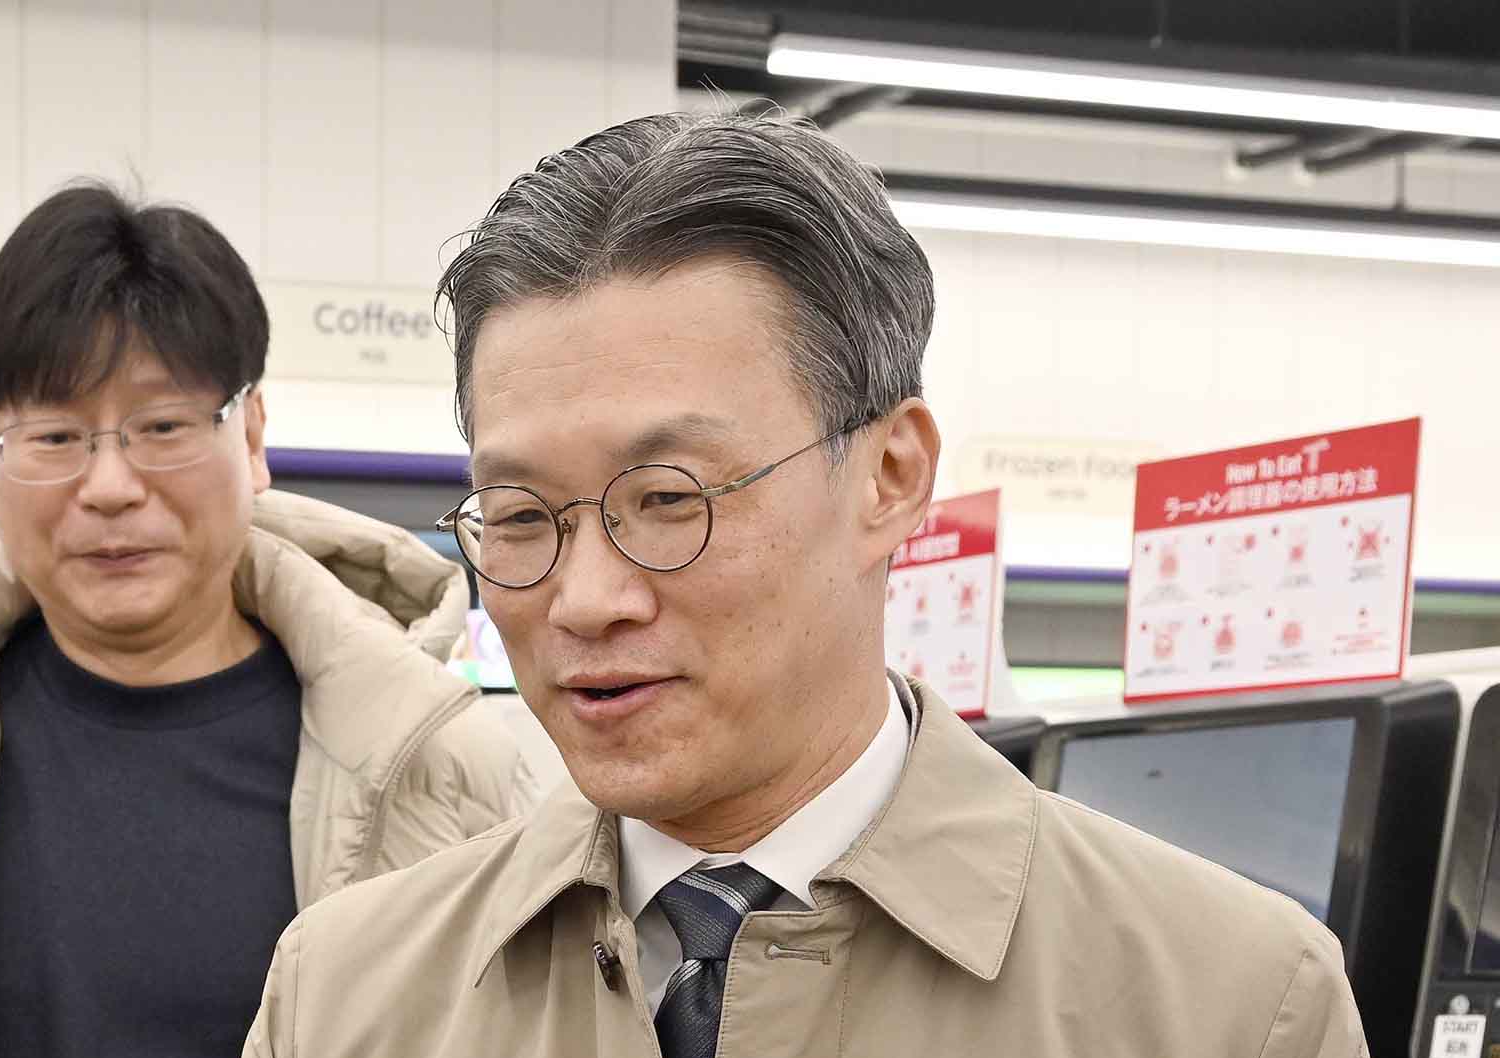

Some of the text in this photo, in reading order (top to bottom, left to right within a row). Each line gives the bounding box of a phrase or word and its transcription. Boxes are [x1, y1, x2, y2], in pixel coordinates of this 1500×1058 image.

[313, 301, 433, 339] Coffee
[984, 450, 1138, 475] Frozen Foo
